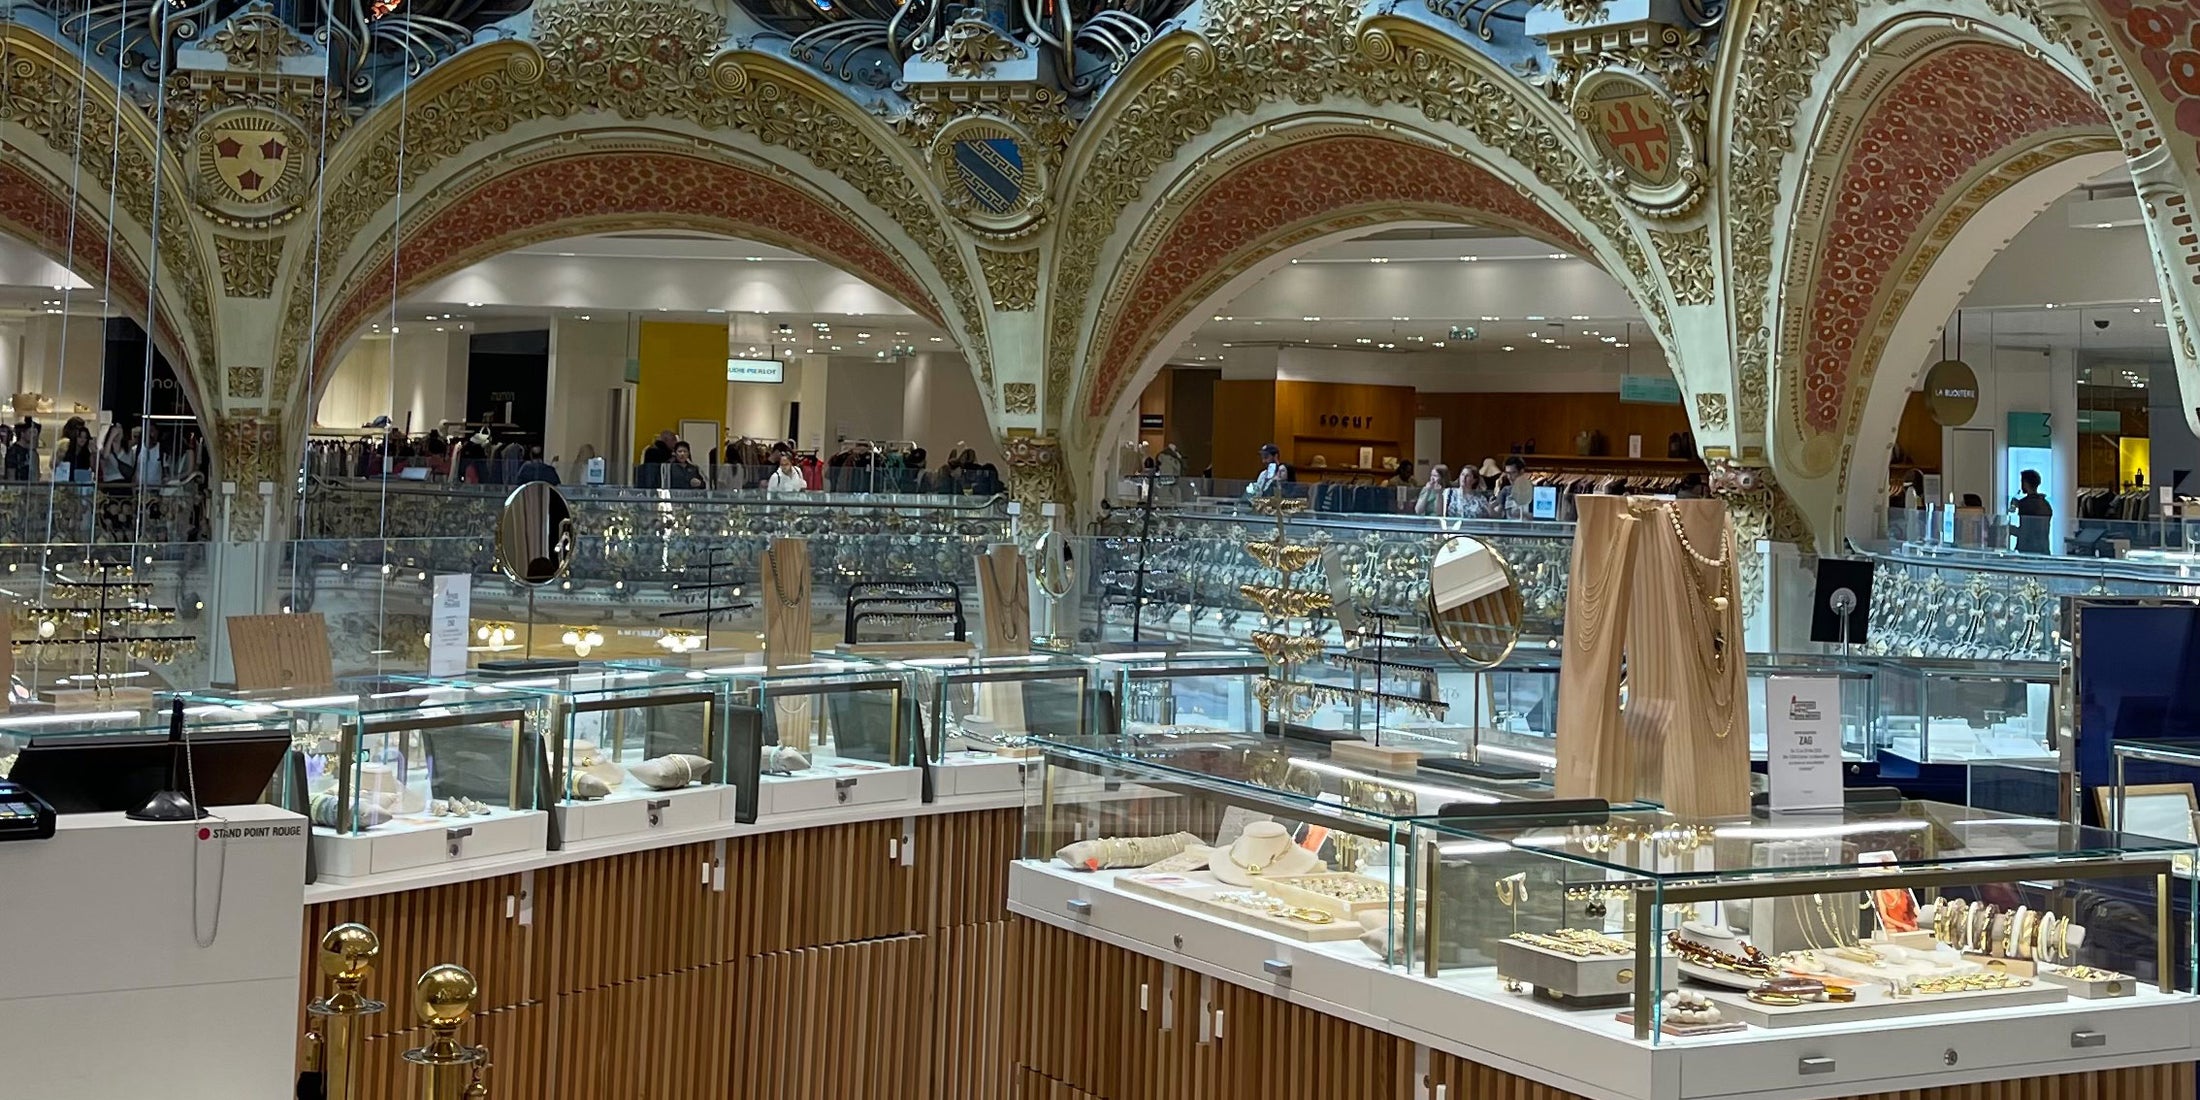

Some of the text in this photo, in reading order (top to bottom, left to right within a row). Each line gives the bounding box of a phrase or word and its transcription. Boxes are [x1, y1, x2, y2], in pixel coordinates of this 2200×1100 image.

[1945, 389, 1975, 398] BIJOUTERIE
[1320, 414, 1373, 429] soeur
[2041, 412, 2052, 437] 3
[1799, 736, 1813, 745] ZAG
[213, 826, 302, 838] STAND POINT ROUGE
